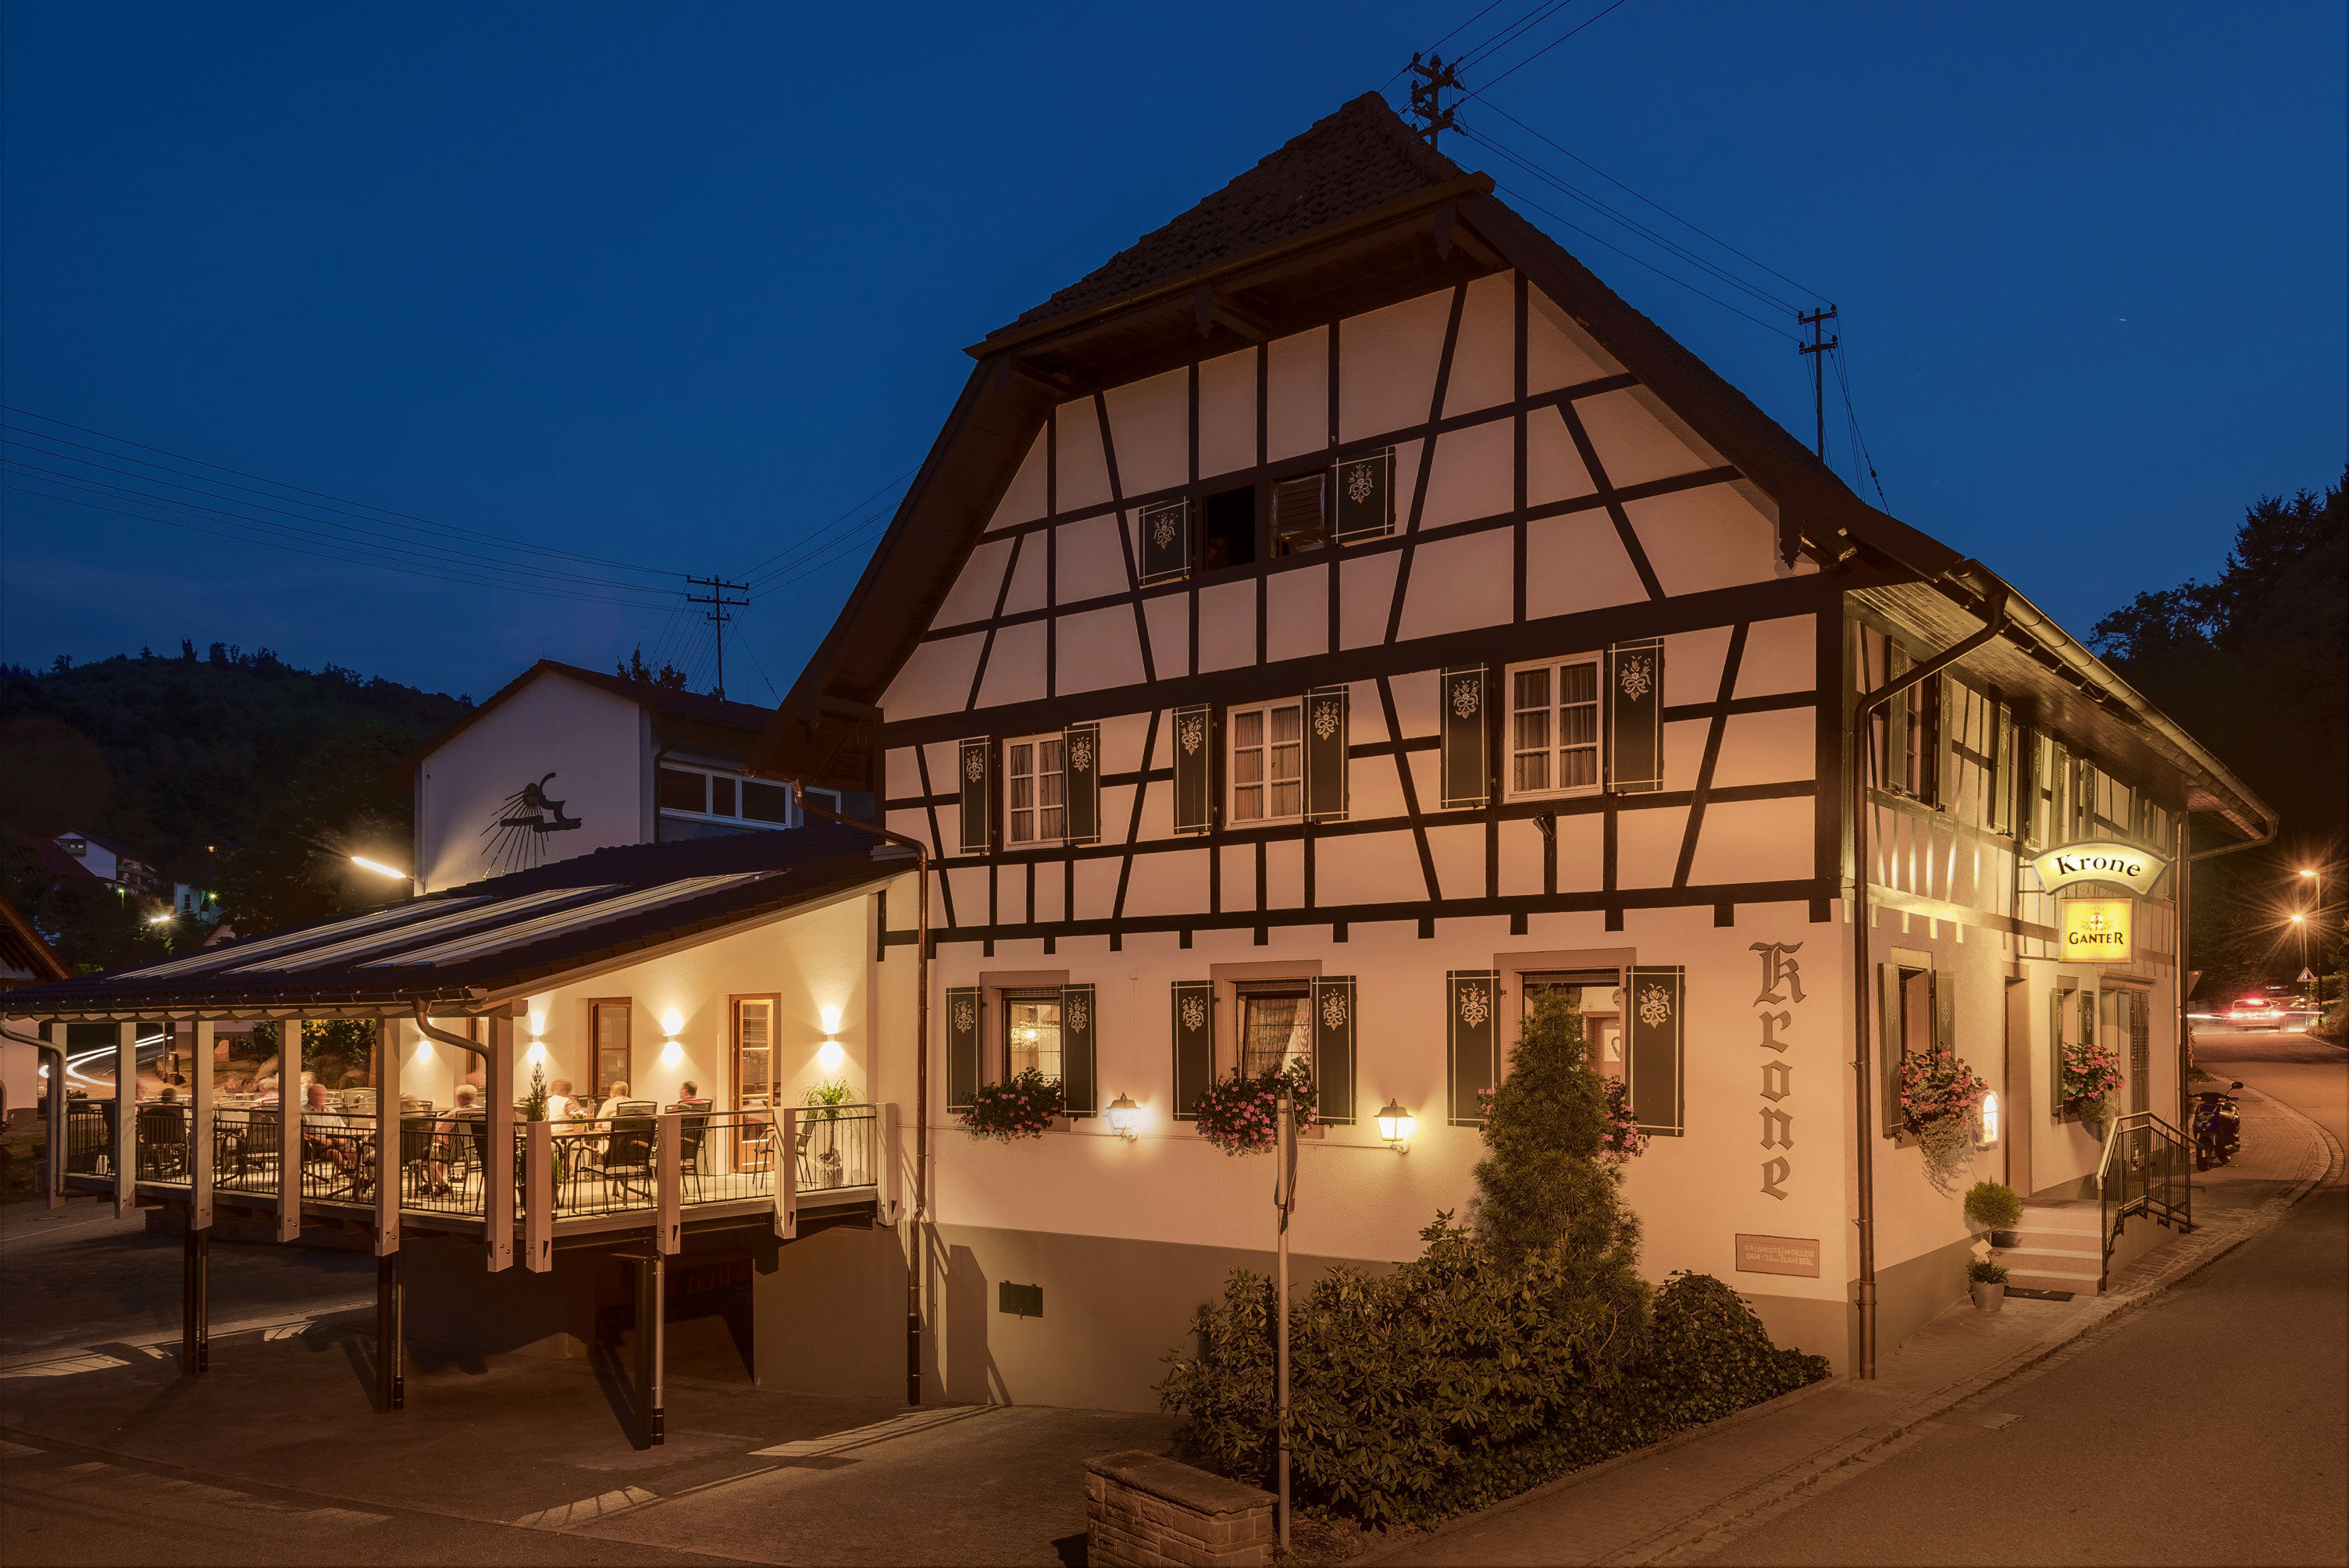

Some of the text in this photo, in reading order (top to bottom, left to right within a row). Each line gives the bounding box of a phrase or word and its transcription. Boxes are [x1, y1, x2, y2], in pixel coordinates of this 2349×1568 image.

[2055, 853, 2140, 877] Krone
[2069, 932, 2124, 945] GANTER
[1748, 941, 1807, 1201] Krone
